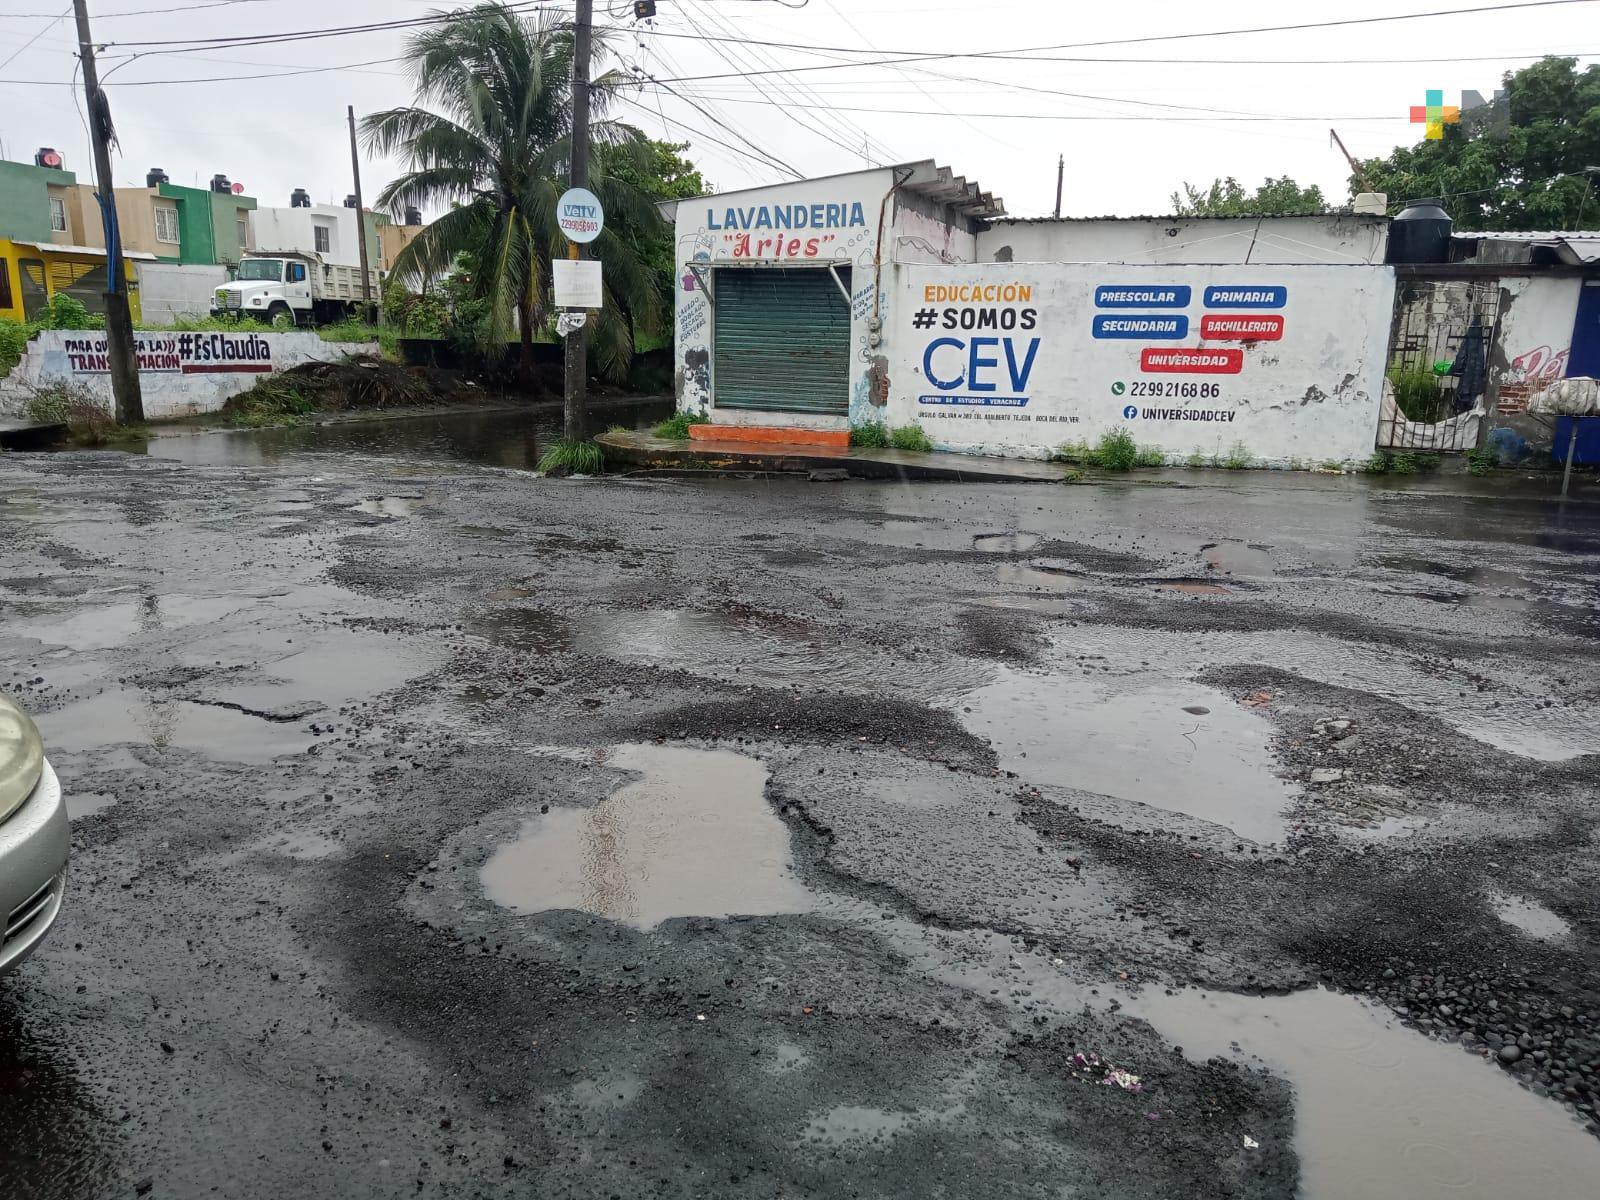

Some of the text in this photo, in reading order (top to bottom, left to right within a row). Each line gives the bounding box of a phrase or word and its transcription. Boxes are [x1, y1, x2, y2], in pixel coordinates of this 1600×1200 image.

[707, 202, 865, 230] LAVANDERIA
[1100, 292, 1175, 302] PREESCOLAR
[1211, 292, 1274, 303] PRIMARIA
[912, 307, 1038, 330] #SOMOS
[1101, 320, 1177, 332] SECUNDARIA
[1207, 321, 1279, 332] BACHILLERATO
[65, 340, 92, 352] PARA
[178, 334, 271, 360] #EsClaudia
[923, 337, 1041, 393] CEV
[1148, 355, 1228, 366] UNIVERSIDAD
[1142, 408, 1236, 422] UNIVERSIDADCEV
